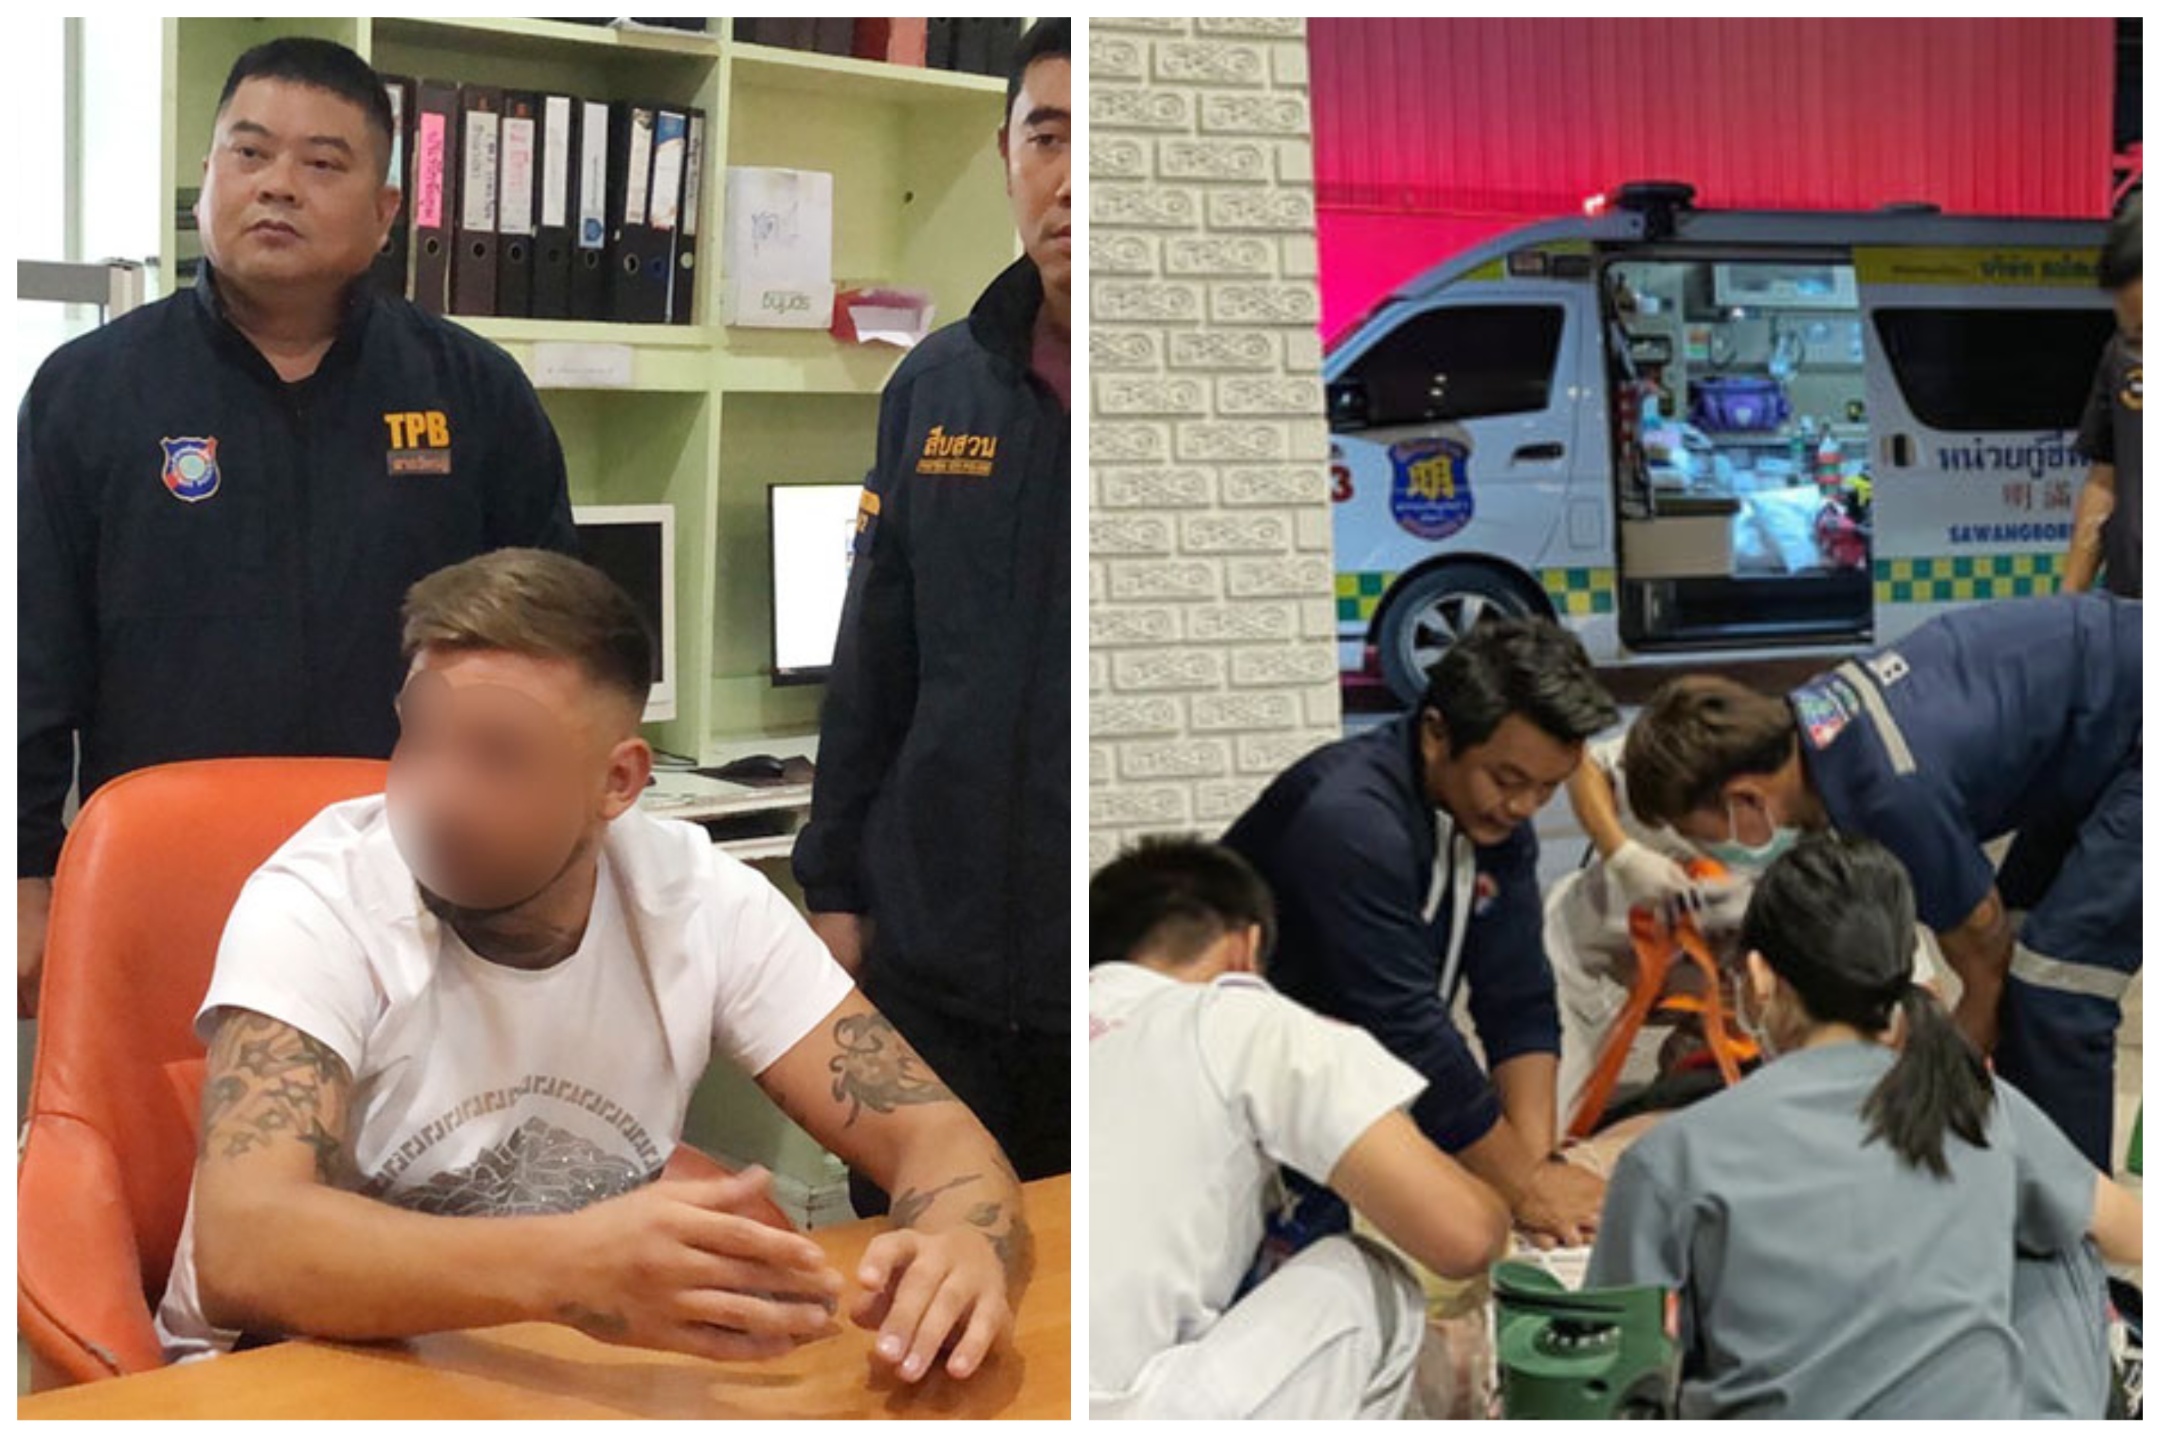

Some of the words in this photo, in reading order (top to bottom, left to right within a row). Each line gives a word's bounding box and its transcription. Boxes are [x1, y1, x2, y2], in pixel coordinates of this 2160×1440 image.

[384, 411, 450, 449] TPB
[923, 424, 997, 459] สืบสวน
